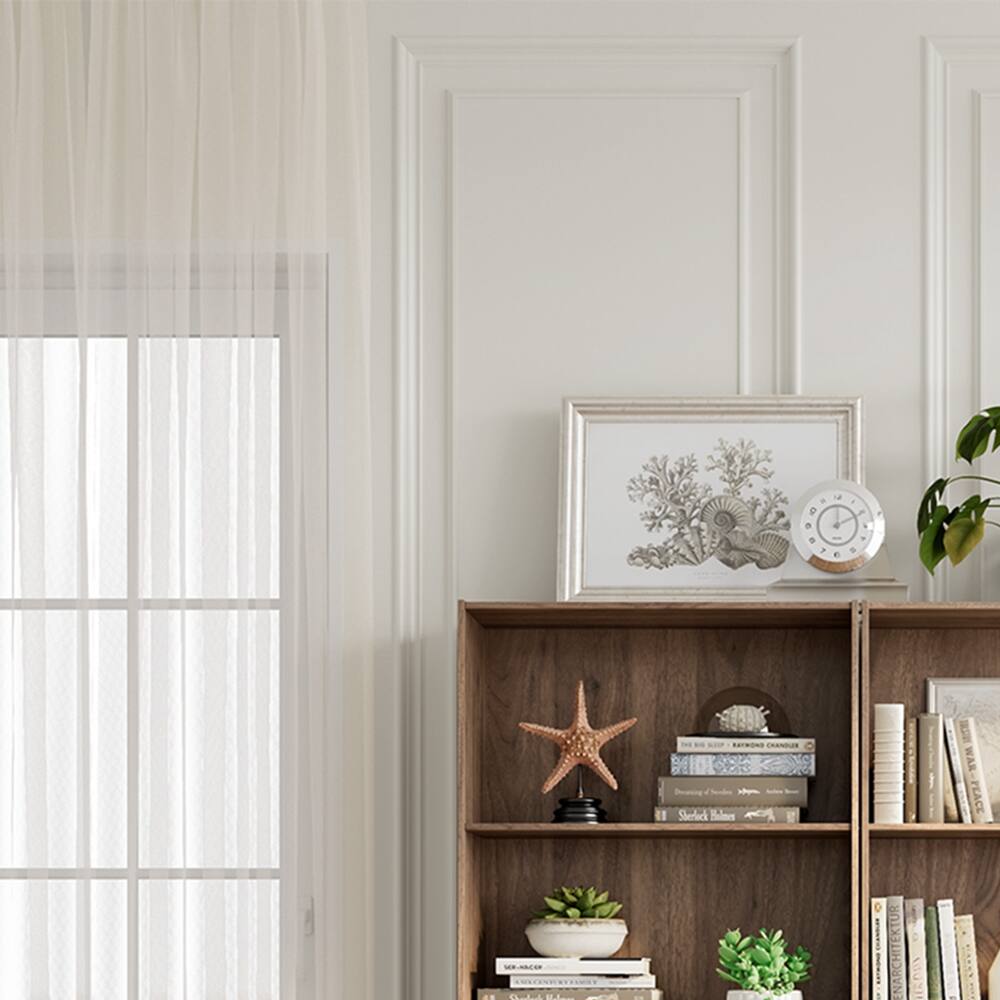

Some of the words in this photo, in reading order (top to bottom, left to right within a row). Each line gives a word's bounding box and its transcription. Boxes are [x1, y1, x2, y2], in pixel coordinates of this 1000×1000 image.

[965, 746, 976, 772] WAR
[971, 780, 985, 815] PEACE
[678, 809, 708, 821] Sherlock
[710, 809, 735, 821] Holmes
